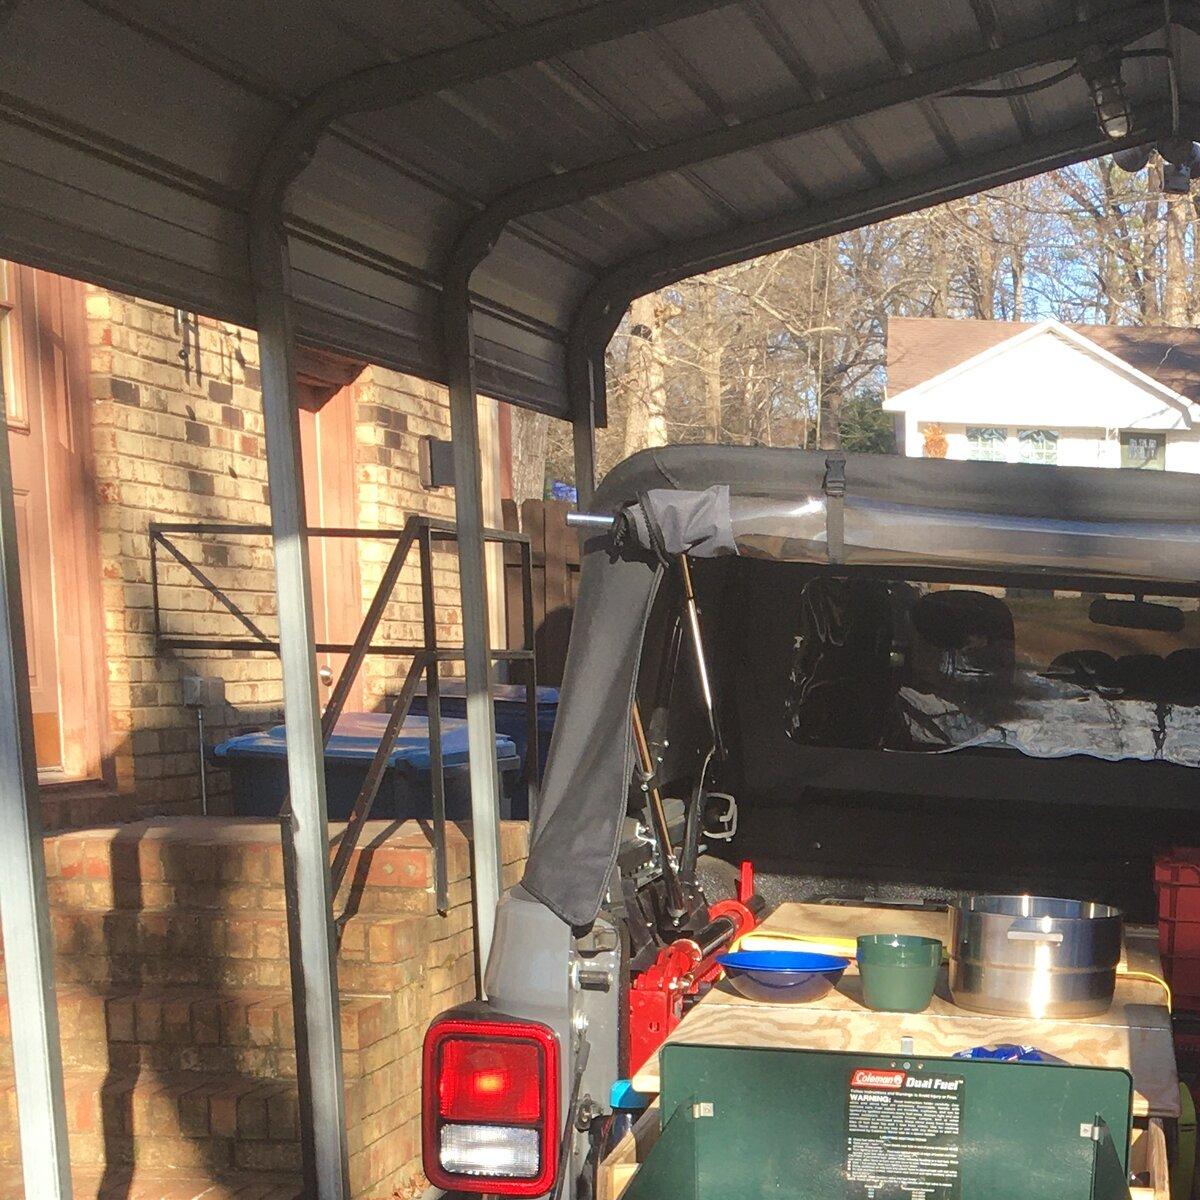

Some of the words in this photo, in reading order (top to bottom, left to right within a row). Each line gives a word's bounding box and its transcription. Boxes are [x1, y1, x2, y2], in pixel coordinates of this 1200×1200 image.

[856, 1072, 894, 1084] Coleman
[906, 1077, 932, 1089] Dual
[849, 1094, 891, 1103] WARNING:
